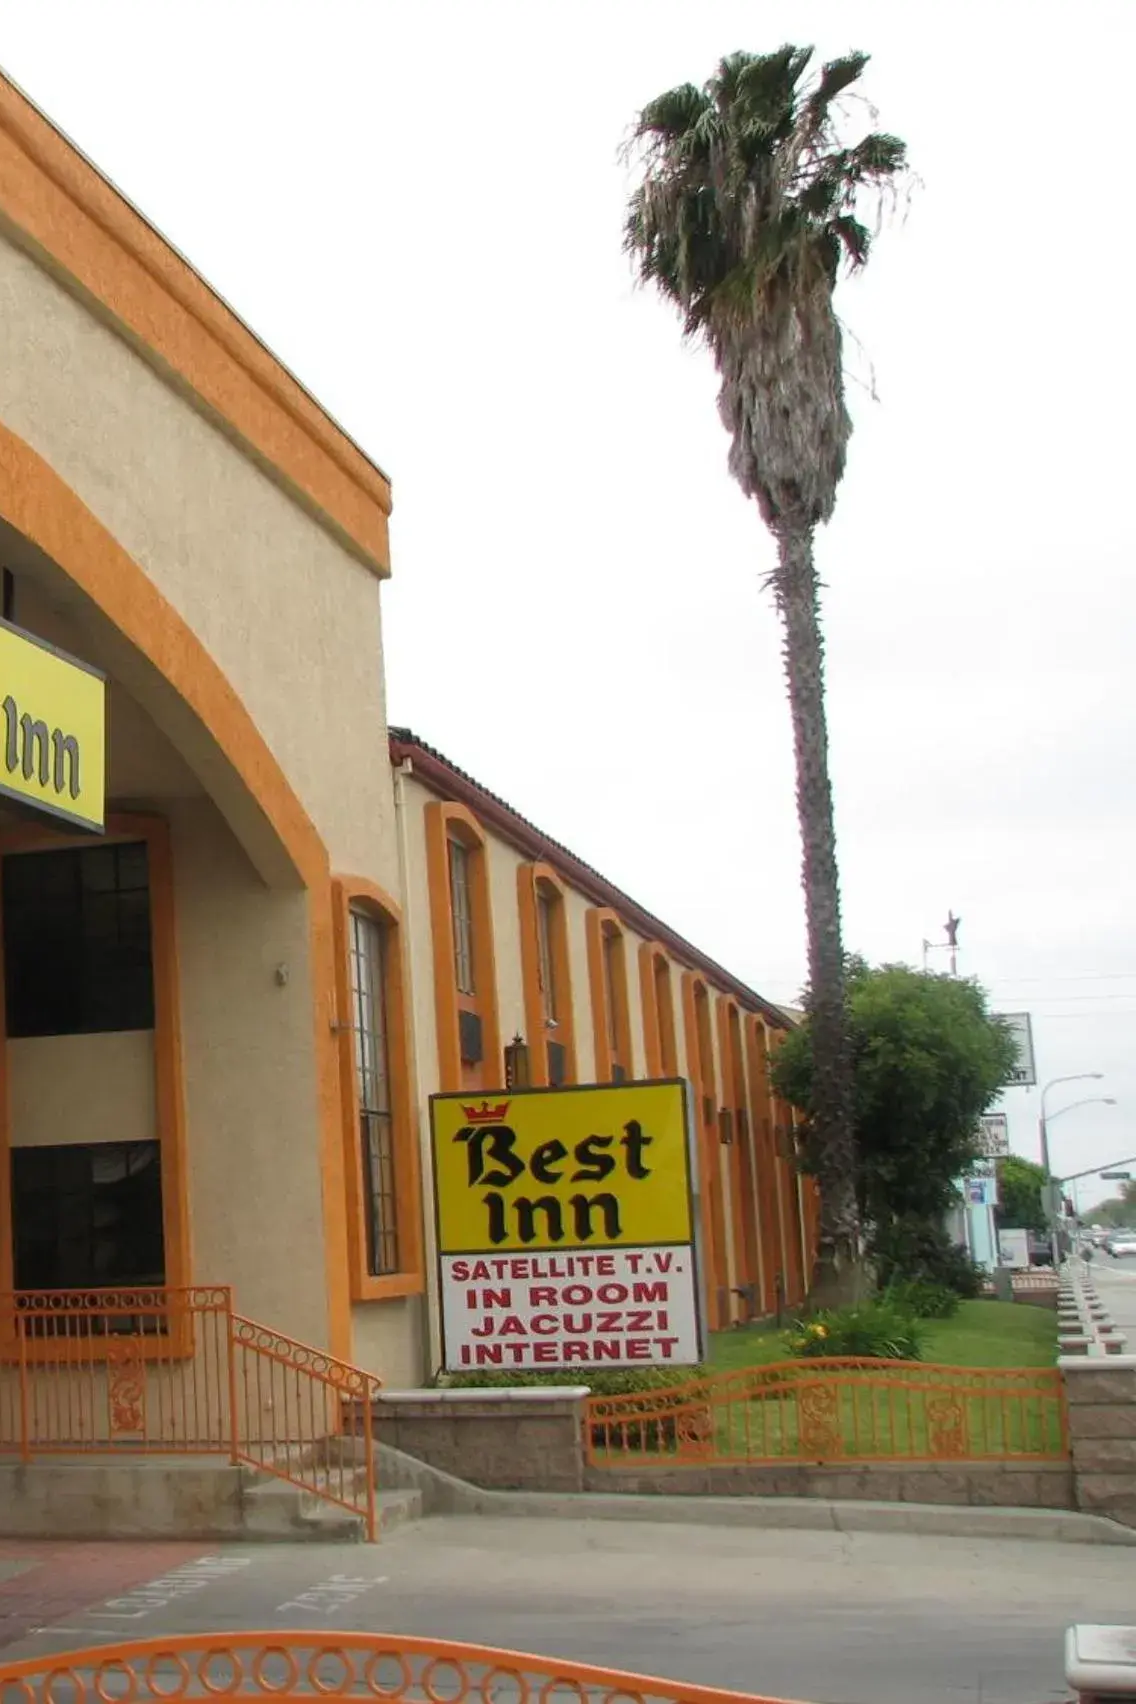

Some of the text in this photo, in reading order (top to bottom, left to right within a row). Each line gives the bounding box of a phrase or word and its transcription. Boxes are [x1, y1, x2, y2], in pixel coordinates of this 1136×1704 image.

[452, 1119, 654, 1188] Best
[451, 1252, 684, 1282] SATELLITE T.V.
[466, 1281, 669, 1309] IN ROOM
[470, 1310, 669, 1337] JACUZZI
[460, 1336, 680, 1365] INTERNET
